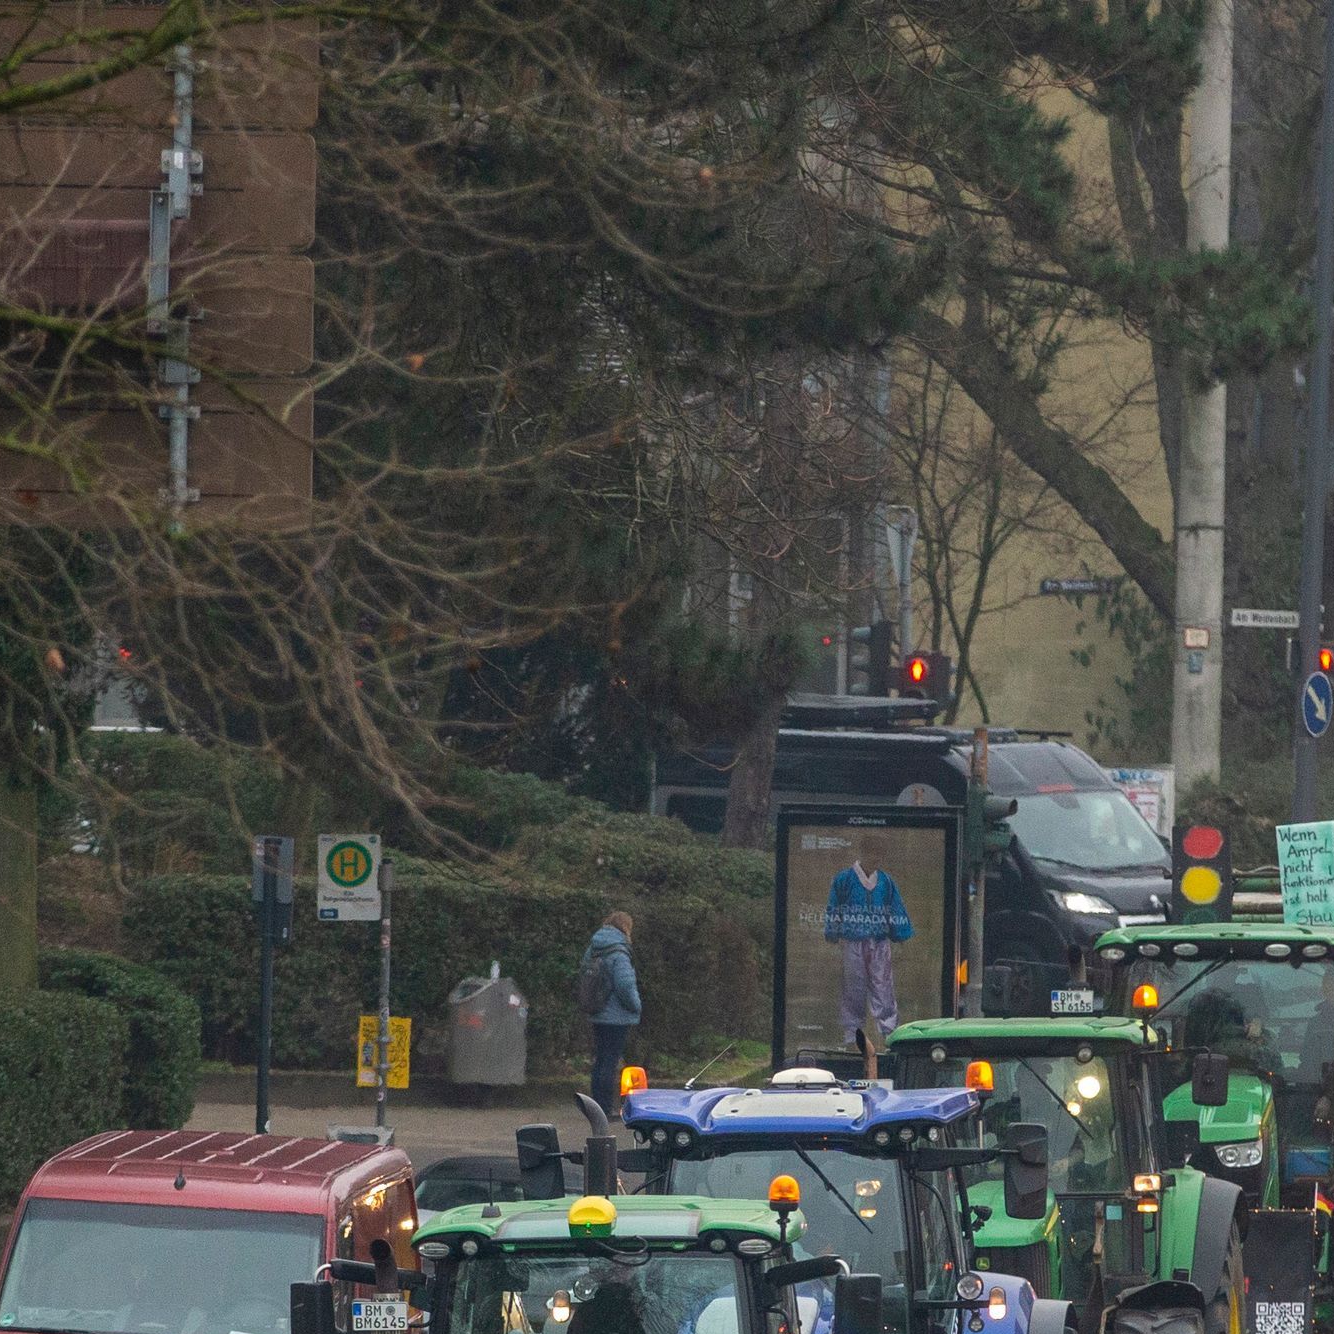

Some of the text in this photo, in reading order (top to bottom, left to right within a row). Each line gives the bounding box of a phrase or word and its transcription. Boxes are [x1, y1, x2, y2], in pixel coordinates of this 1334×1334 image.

[1278, 827, 1317, 842] Wenn
[340, 851, 359, 878] H
[1283, 860, 1314, 878] nicht
[1306, 889, 1329, 903] halt
[799, 912, 908, 925] HELENA PARADA KIM
[365, 1305, 382, 1316] BM
